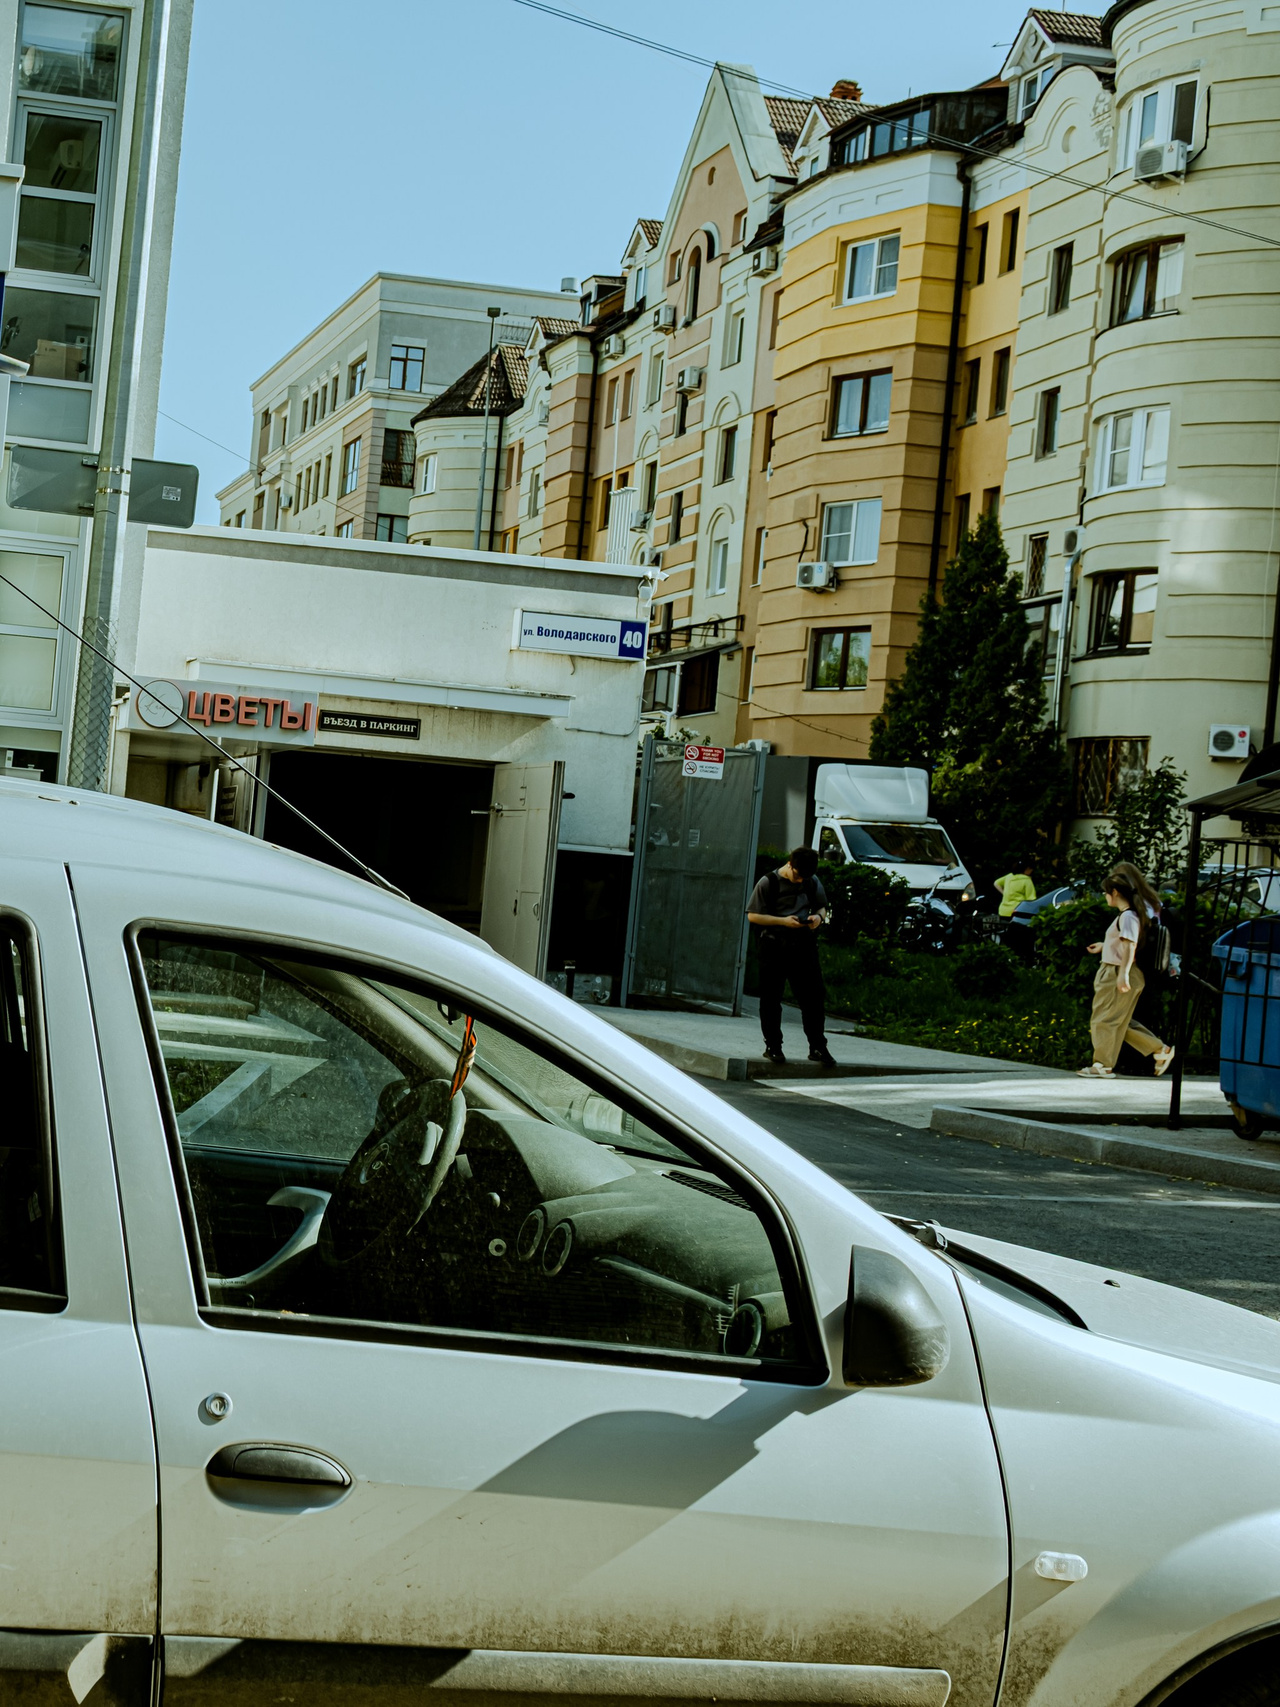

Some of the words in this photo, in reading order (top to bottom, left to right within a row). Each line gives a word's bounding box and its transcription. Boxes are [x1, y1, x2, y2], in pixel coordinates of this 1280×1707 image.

[523, 628, 535, 637] ул.
[536, 625, 617, 644] Володарского
[622, 630, 643, 649] 40
[187, 690, 313, 732] ЦВЕТЫ
[323, 716, 358, 729] ВЪЕЗД
[360, 720, 367, 728] В
[369, 721, 417, 733] ПАРКИНГ
